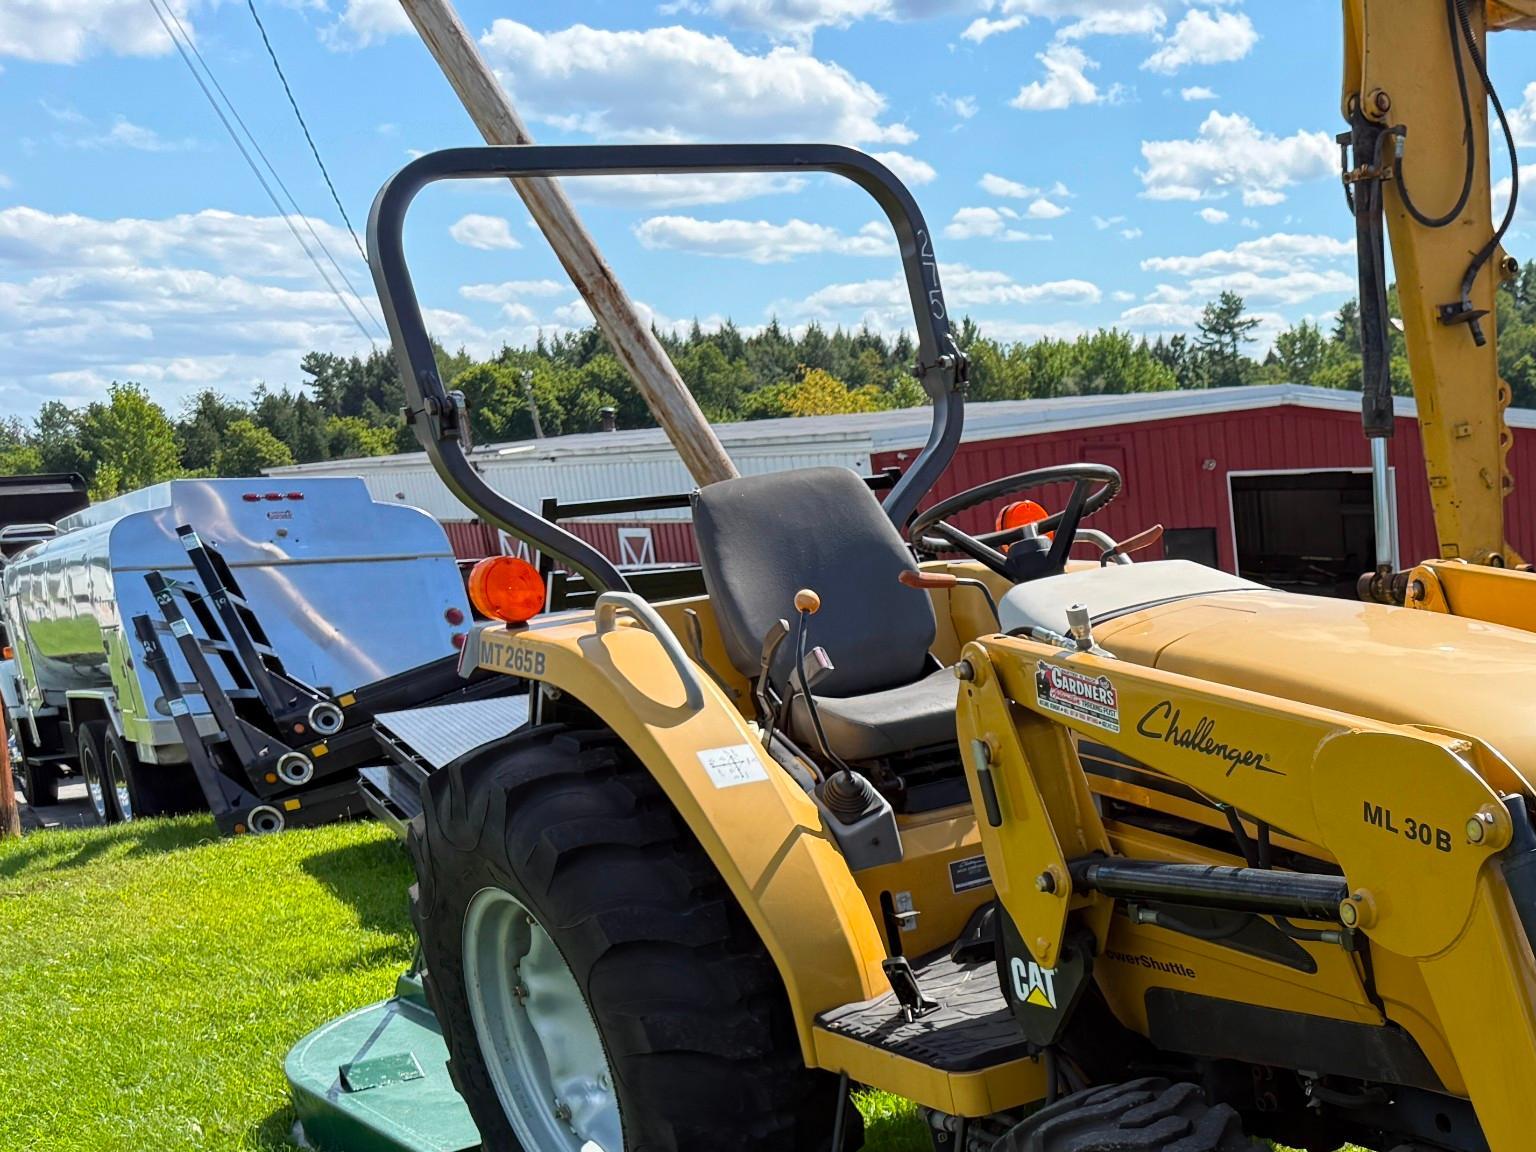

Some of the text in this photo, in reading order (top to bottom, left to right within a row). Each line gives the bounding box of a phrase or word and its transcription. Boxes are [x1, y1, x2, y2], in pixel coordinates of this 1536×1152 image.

[917, 229, 945, 319] 275
[1051, 667, 1115, 706] GARDNERS
[1136, 700, 1287, 777] Challenger
[1363, 800, 1452, 853] ML 30B
[1010, 956, 1057, 1009] CAT
[1105, 950, 1196, 979] owerShuttle
